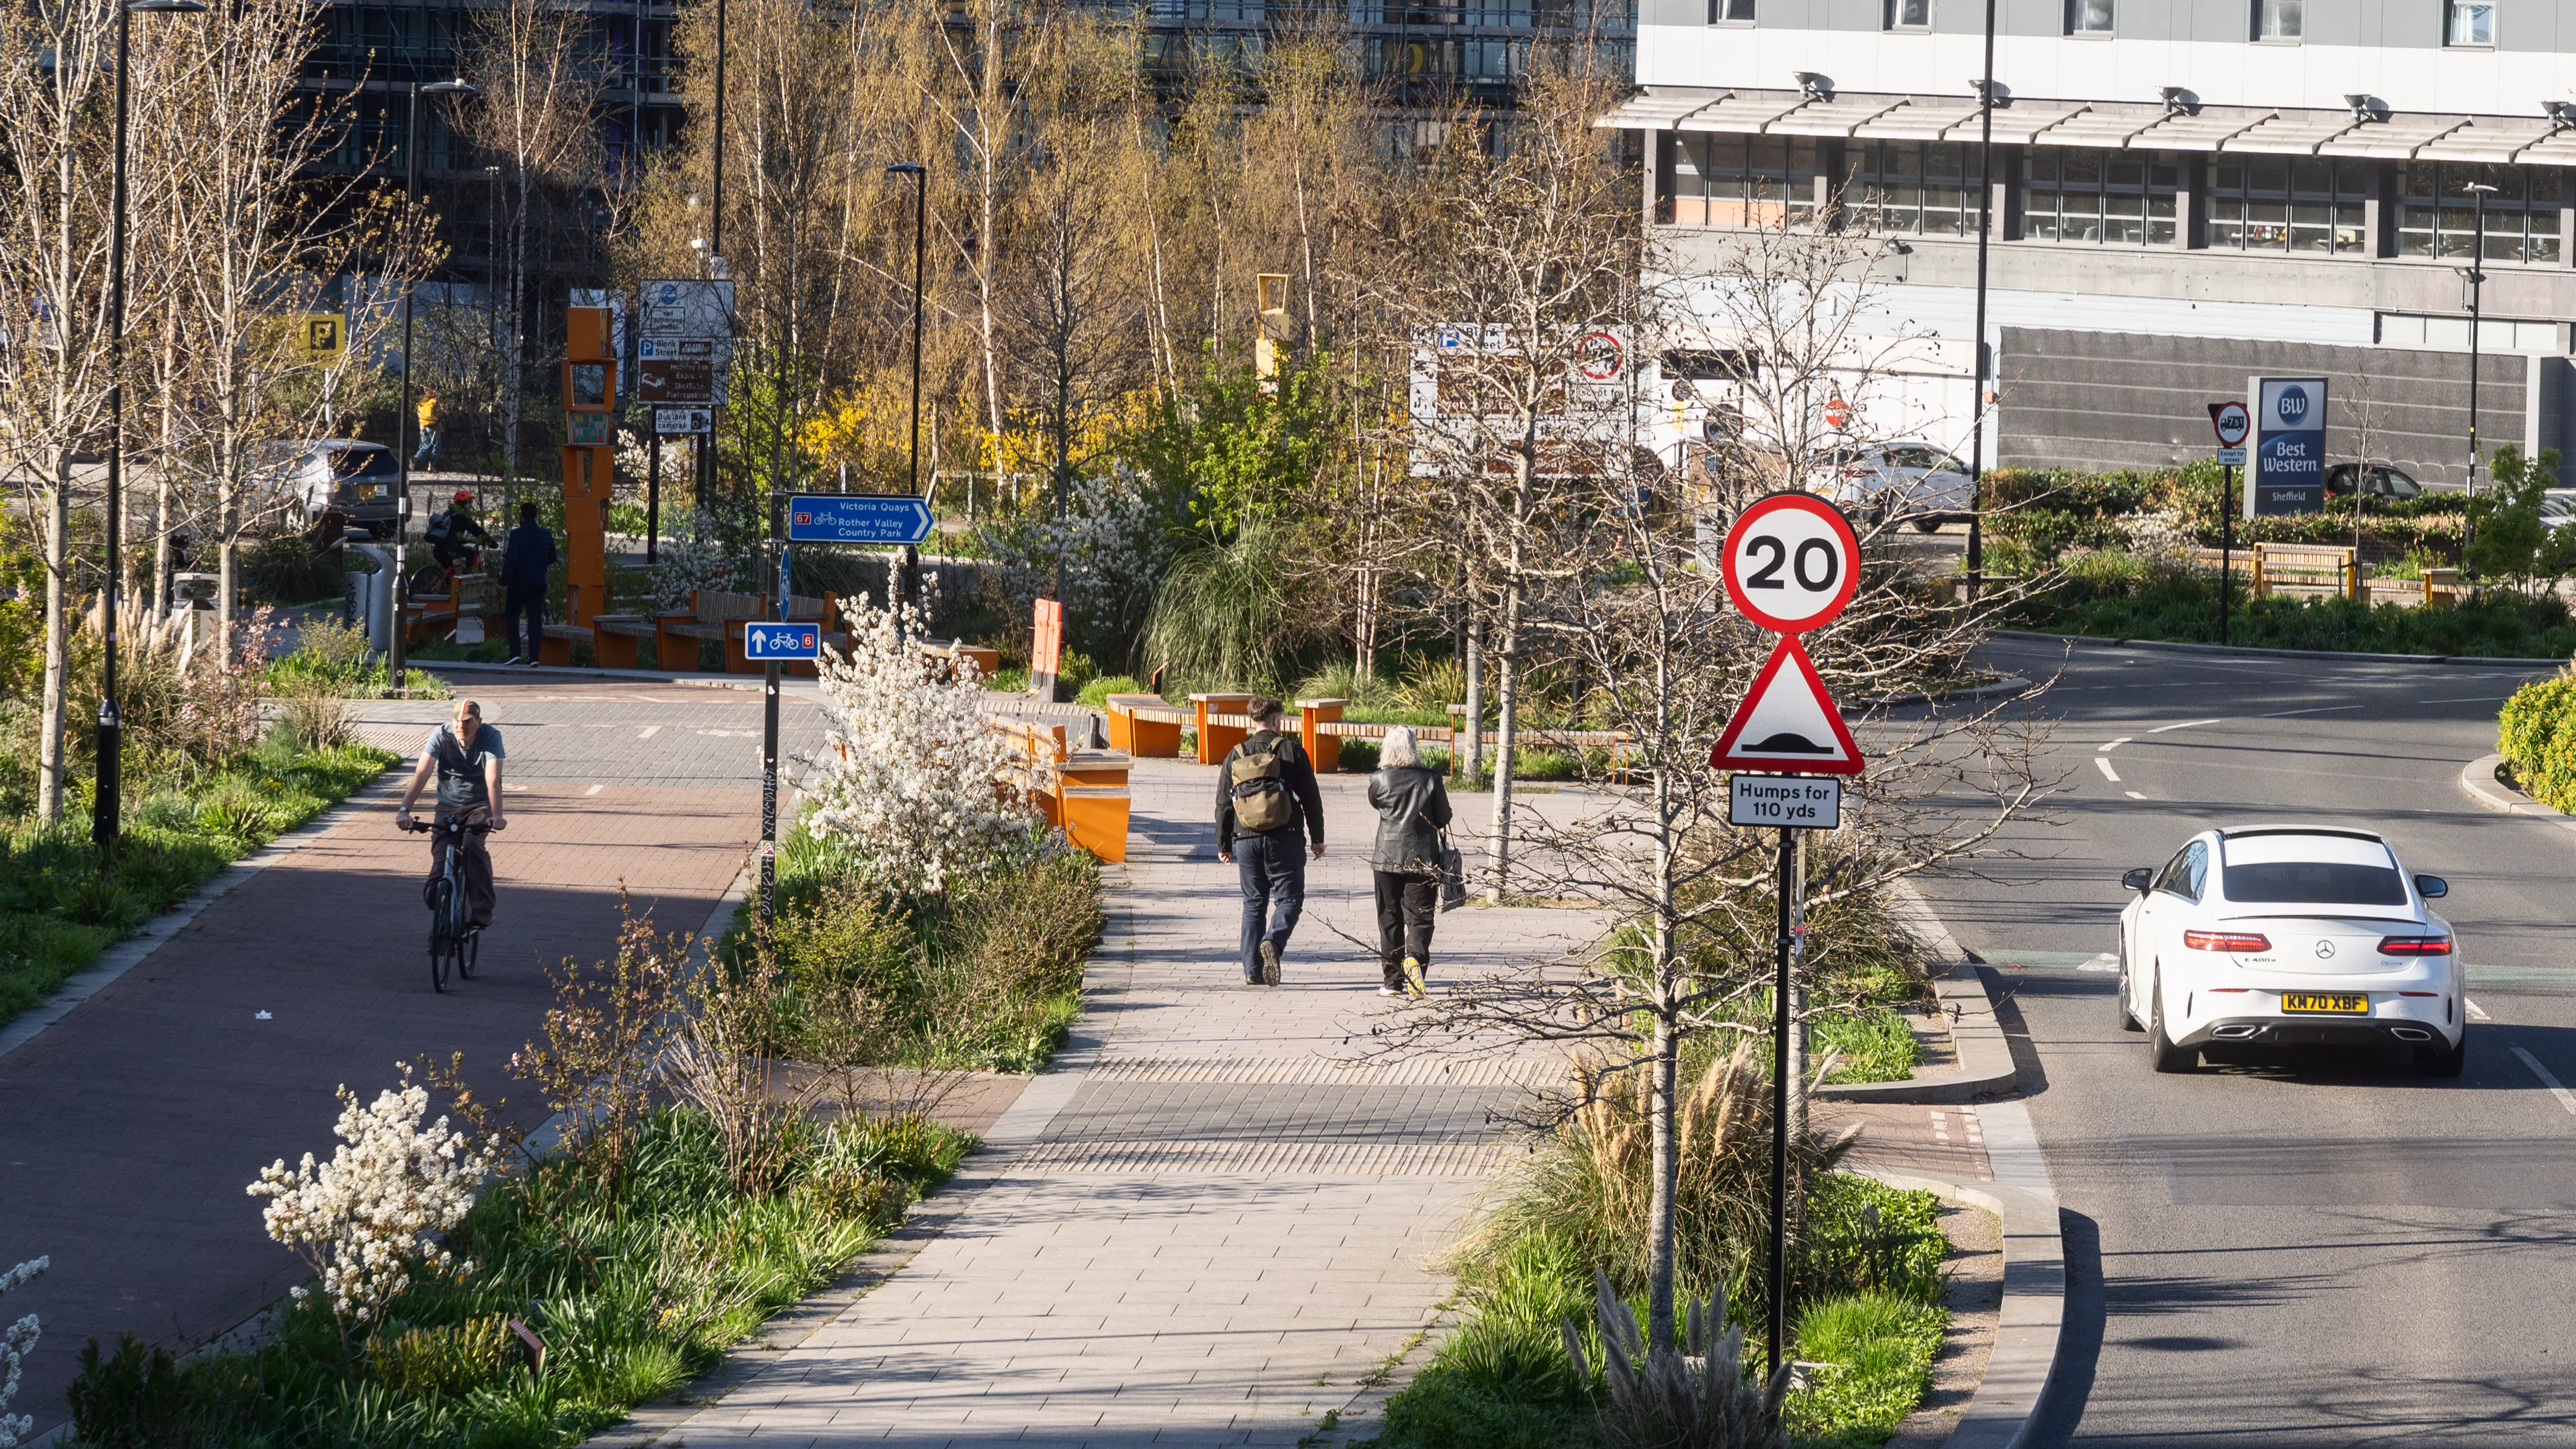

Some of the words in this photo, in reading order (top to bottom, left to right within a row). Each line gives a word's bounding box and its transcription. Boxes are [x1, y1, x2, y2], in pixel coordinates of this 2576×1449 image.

[1466, 327, 1498, 336] Blnk
[644, 342, 651, 354] P
[2281, 398, 2304, 414] BW
[2277, 442, 2306, 456] Best
[2263, 458, 2317, 472] Western
[2272, 491, 2306, 502] Sheffield
[840, 502, 876, 511] Victoria
[880, 503, 909, 513] Quays
[796, 514, 809, 522] 67
[839, 518, 870, 527] Rother
[875, 519, 903, 528] Valley
[839, 528, 876, 538] Country
[880, 529, 902, 537] Park
[1746, 535, 1838, 592] 20
[805, 637, 811, 645] 6
[1740, 783, 1800, 801] Humps
[1805, 785, 1829, 799] for
[1753, 802, 1781, 817] 110
[1786, 804, 1816, 820] yds
[2332, 996, 2361, 1010] XBF
